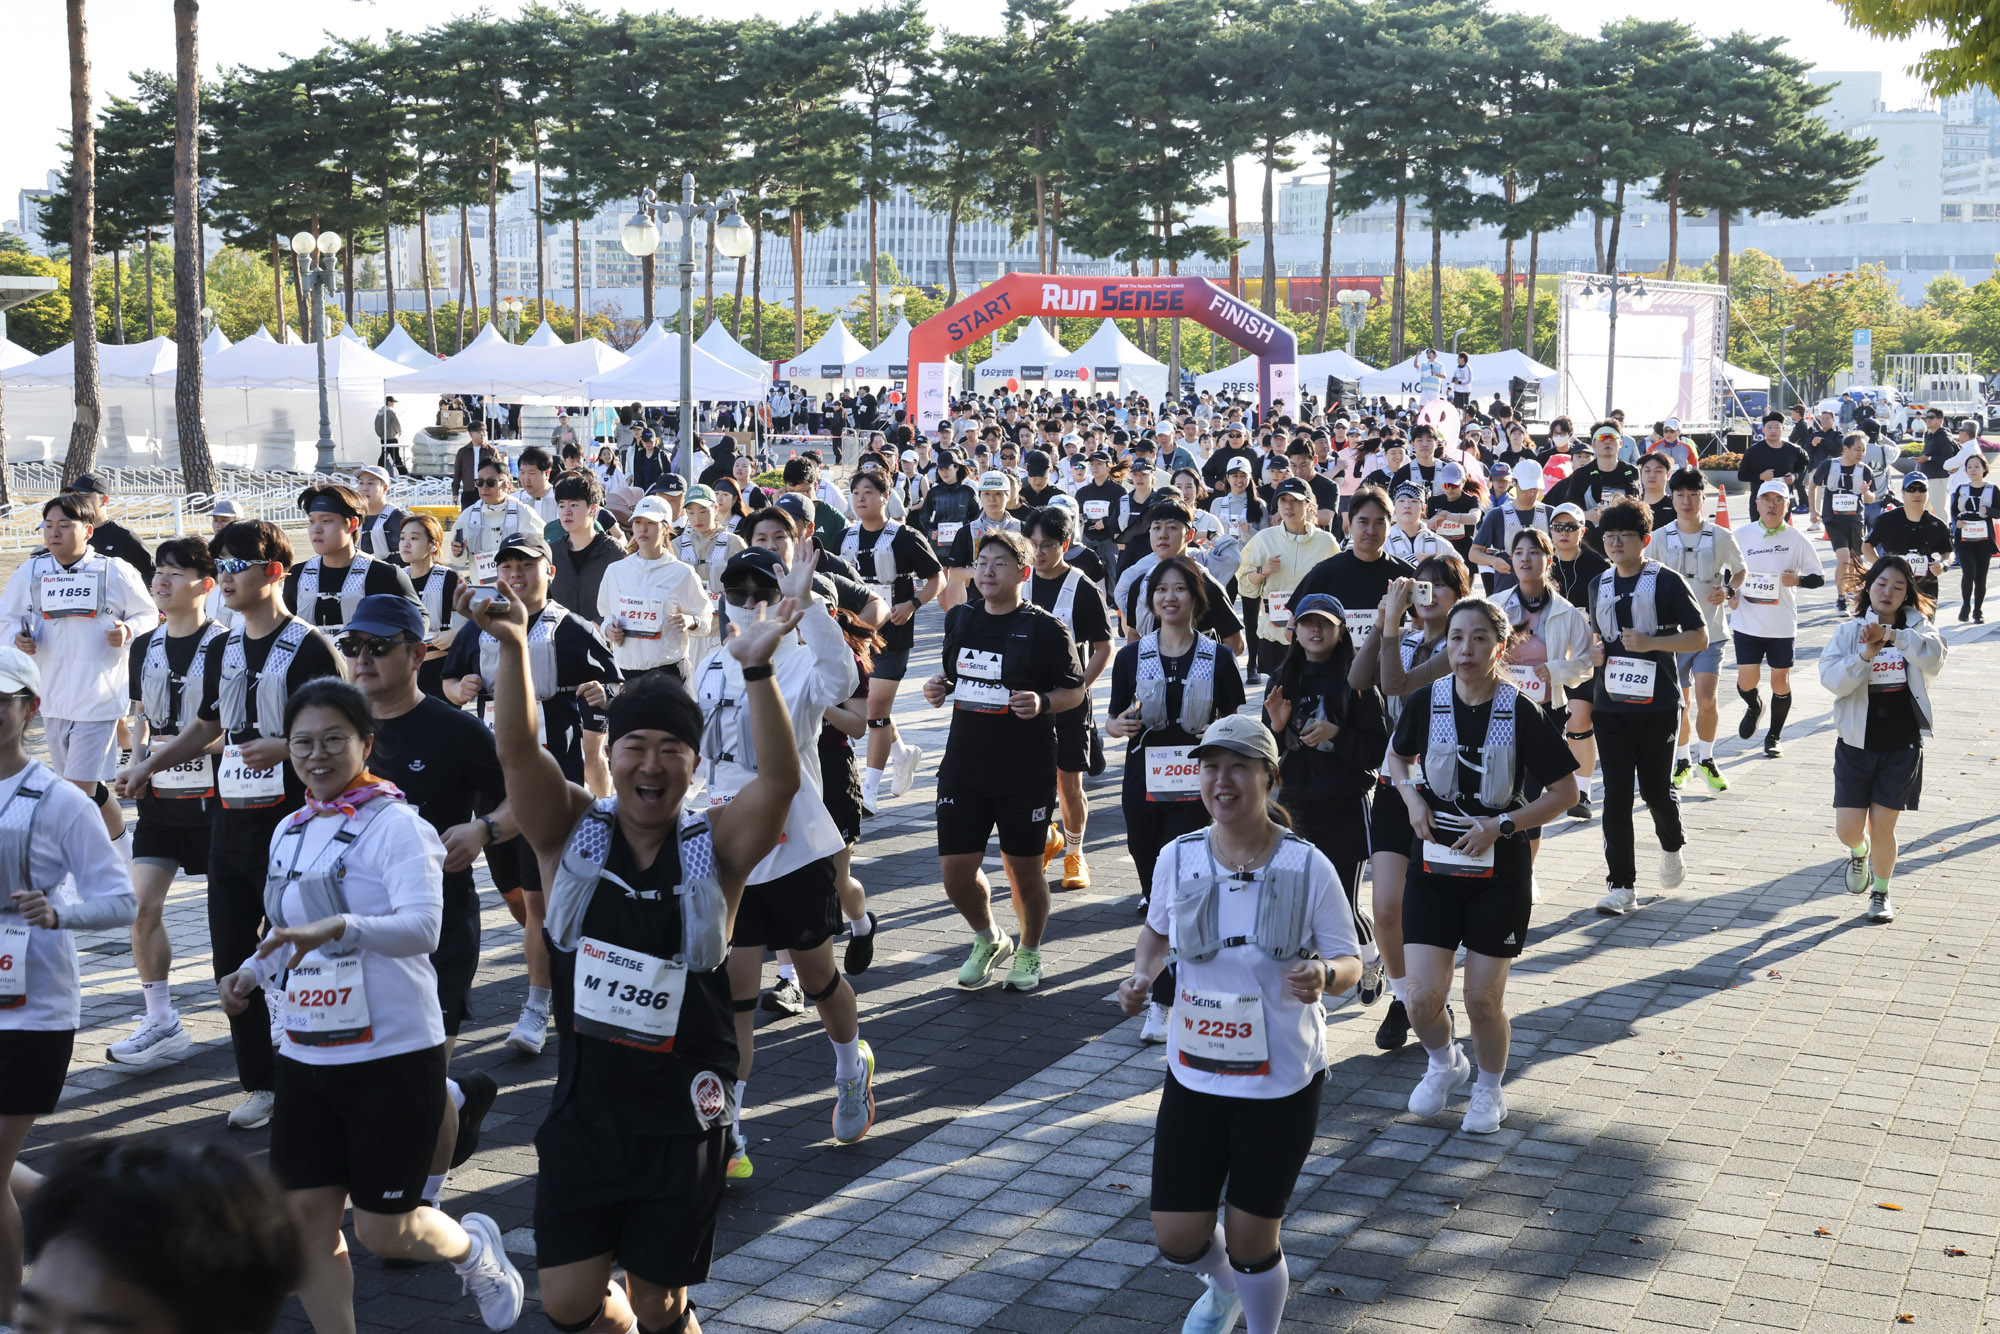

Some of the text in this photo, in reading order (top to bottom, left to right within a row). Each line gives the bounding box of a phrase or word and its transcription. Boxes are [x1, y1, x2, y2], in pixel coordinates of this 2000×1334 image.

[947, 292, 1011, 341] START
[1208, 294, 1275, 344] FINISH
[1857, 332, 1865, 342] F
[1747, 545, 1790, 556] Burning Run
[487, 561, 498, 569] 10
[59, 587, 91, 597] 1855
[1753, 582, 1775, 591] 1495
[708, 592, 719, 601] 26
[628, 610, 657, 621] 2175
[1357, 625, 1371, 635] 12
[1872, 660, 1905, 672] 2343
[1618, 672, 1649, 685] 1828
[1515, 680, 1540, 690] 610
[234, 767, 275, 780] 1662
[1152, 763, 1200, 777] W 2068
[5, 928, 26, 937] 10km
[583, 943, 606, 961] Run
[336, 959, 358, 969] 10km
[288, 987, 353, 1007] W 2207
[584, 975, 601, 991] M
[607, 980, 671, 1010] 1386
[1238, 996, 1259, 1004] 10km
[1184, 1016, 1253, 1039] W 2253
